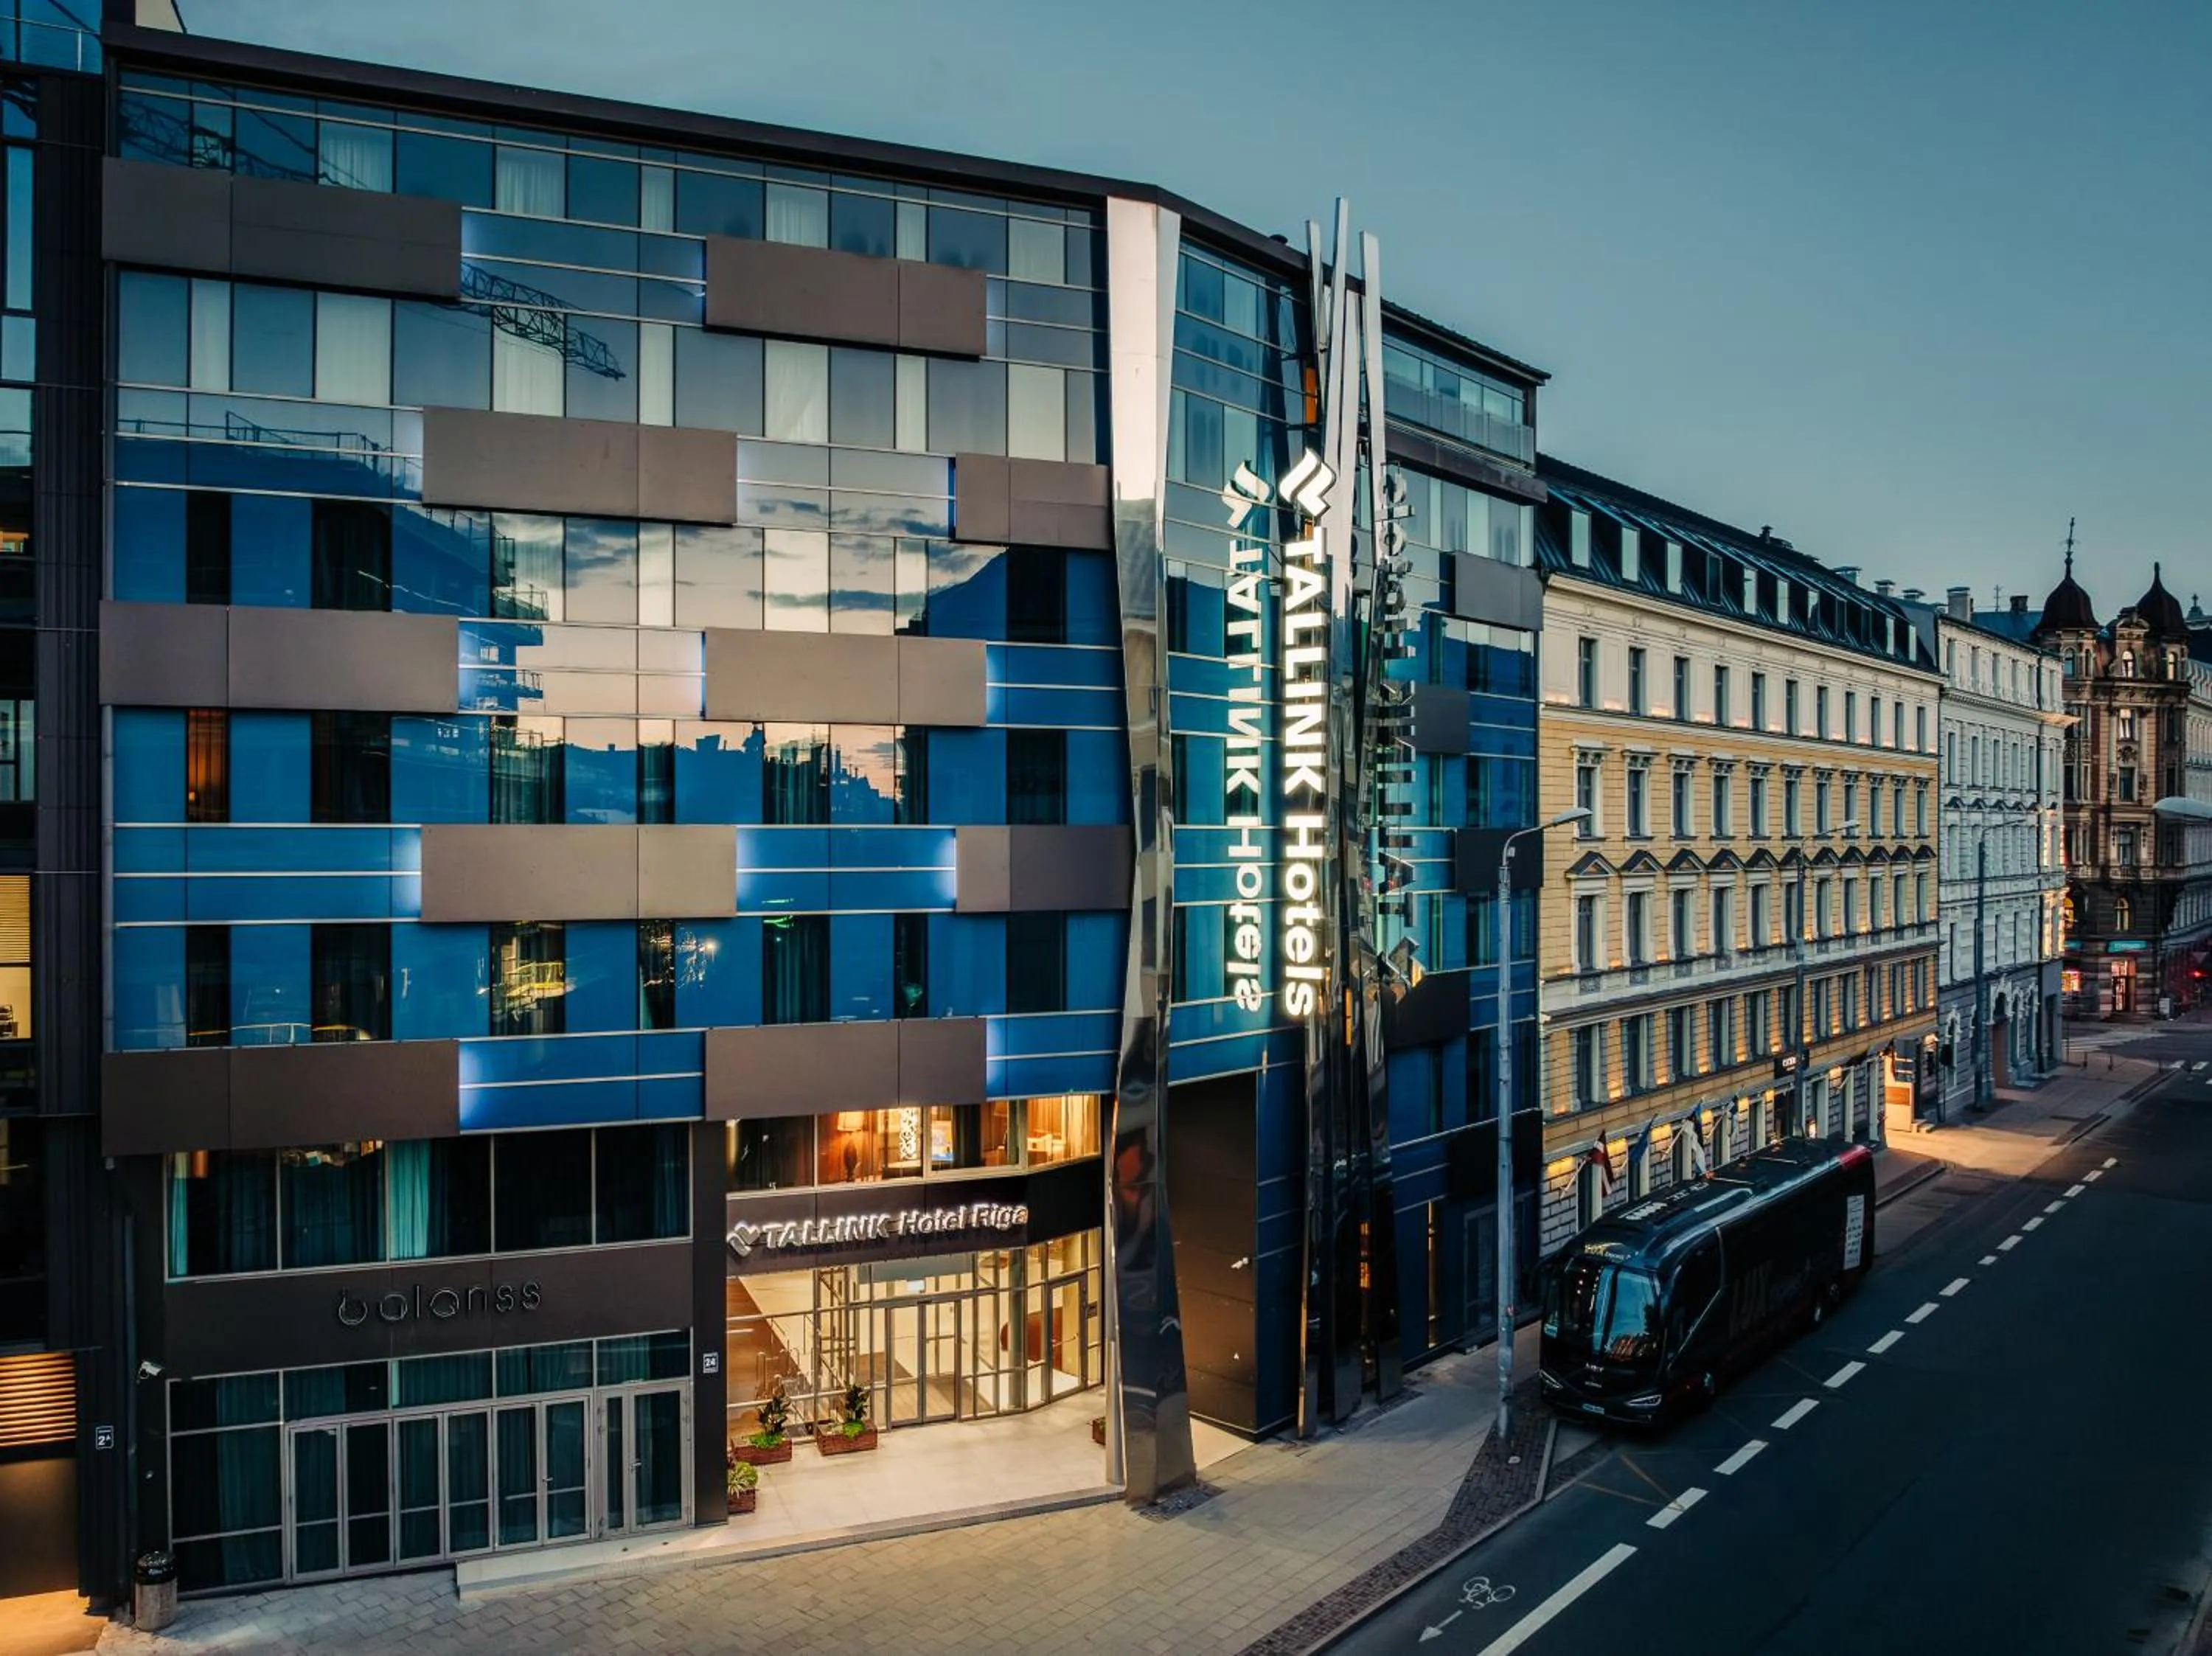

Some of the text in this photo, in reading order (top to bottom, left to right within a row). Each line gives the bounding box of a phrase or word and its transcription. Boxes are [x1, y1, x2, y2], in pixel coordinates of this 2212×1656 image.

[1285, 526, 1326, 1016] TALLINK Hotels
[762, 1201, 1029, 1248] TALLINK Hotel Riga
[338, 1280, 542, 1326] balanss
